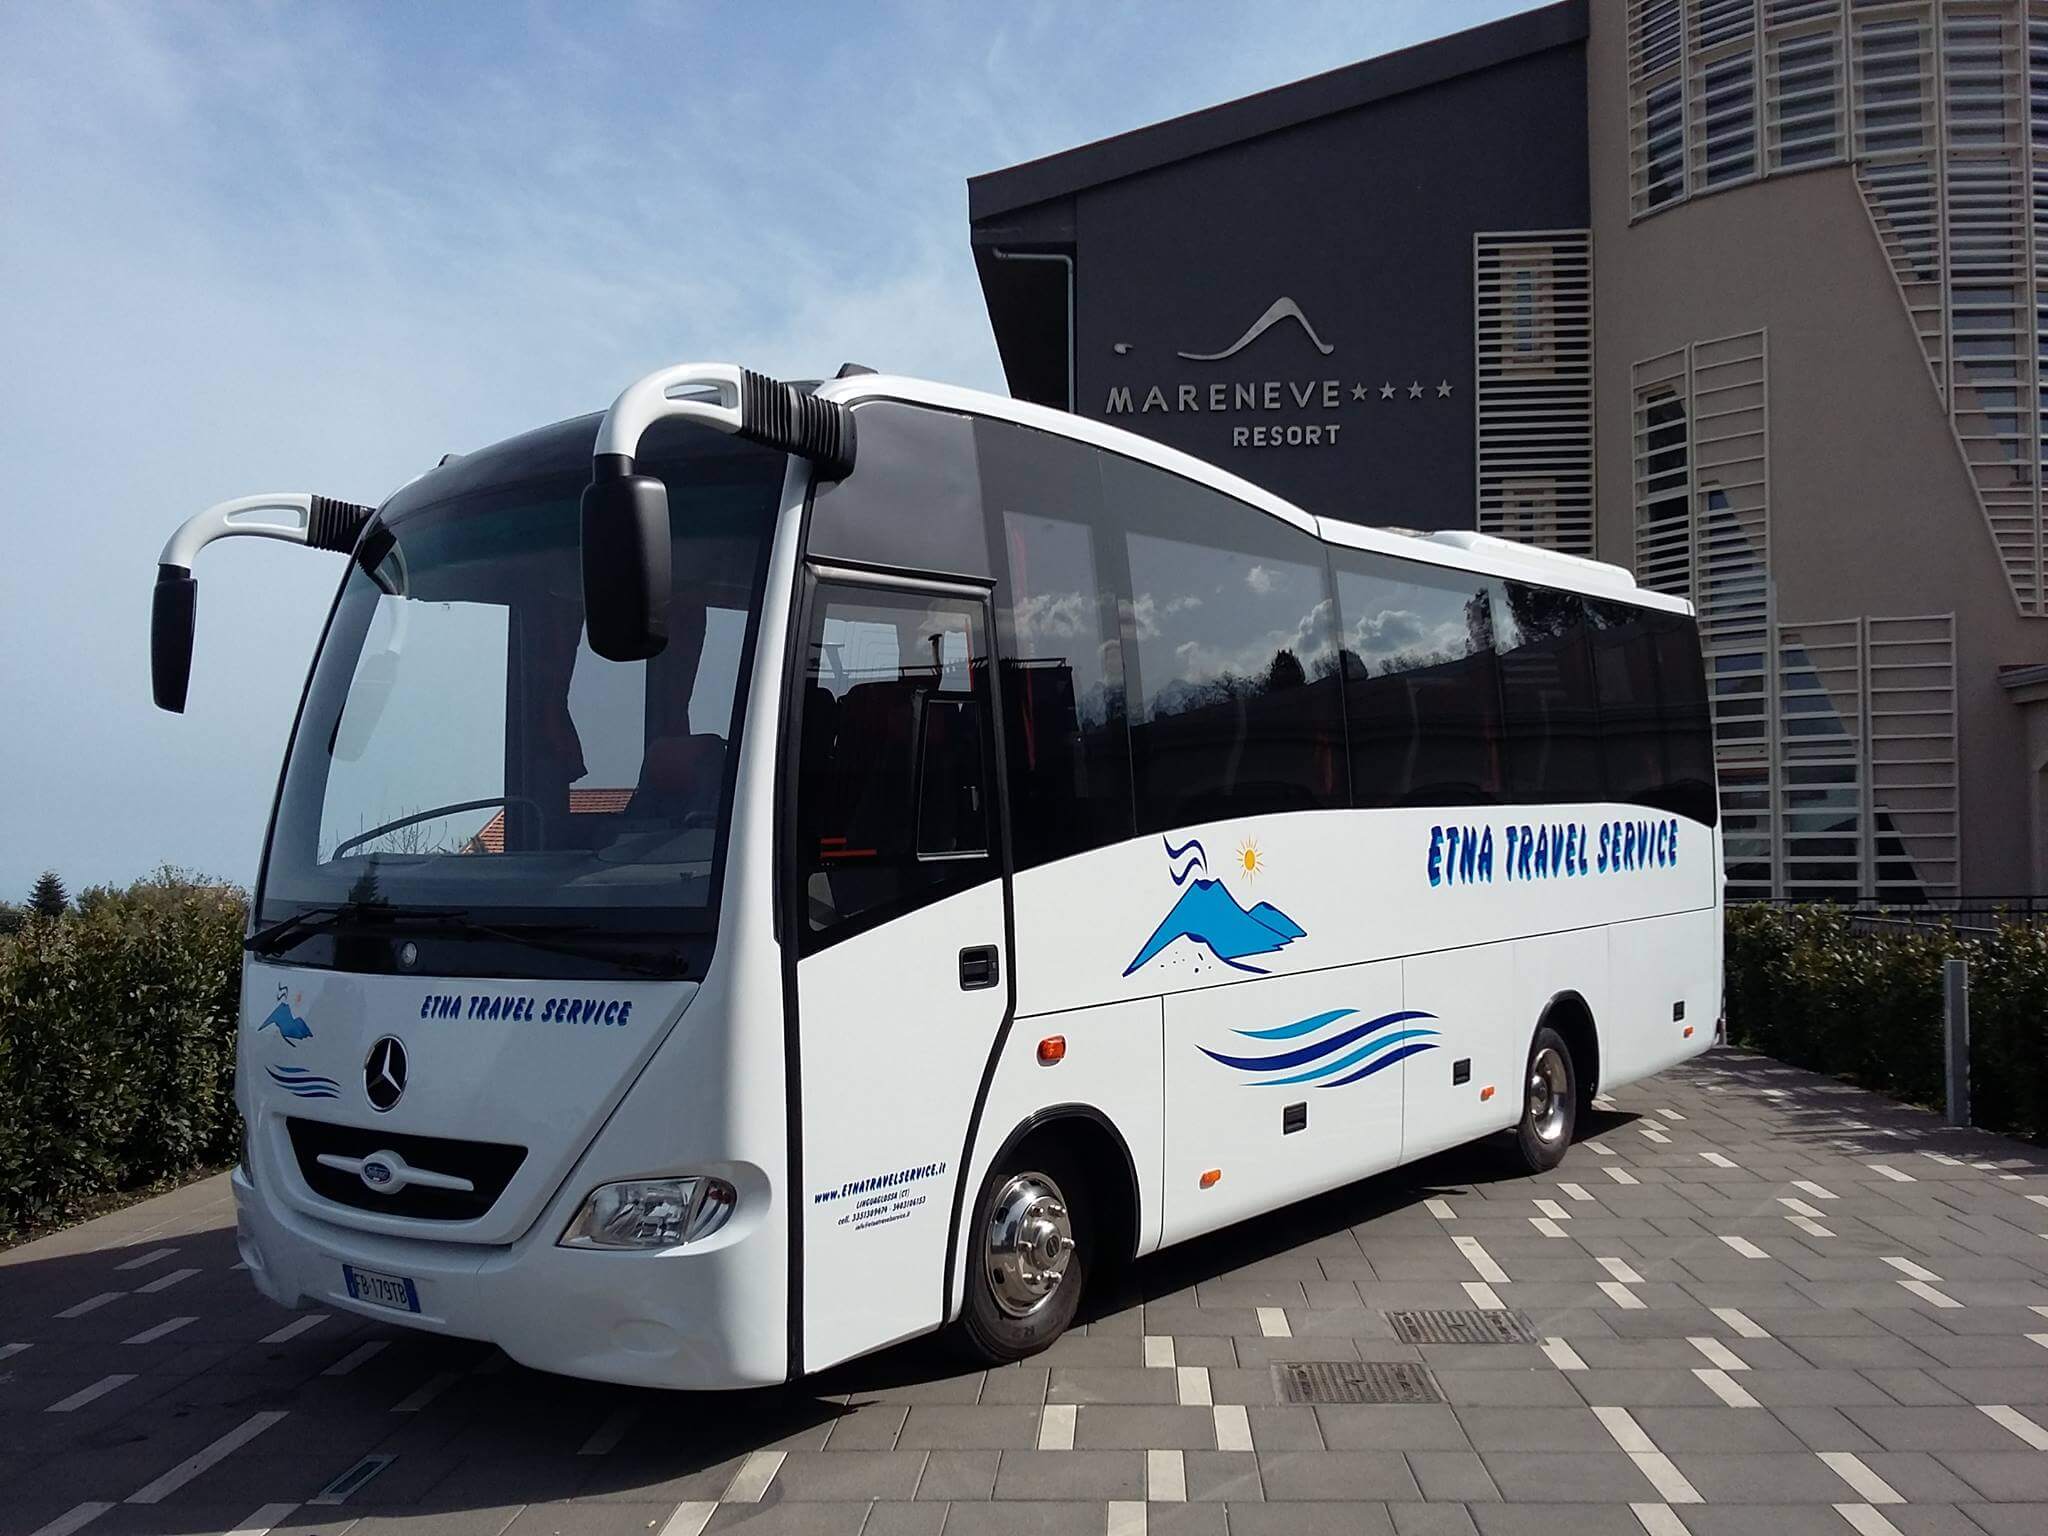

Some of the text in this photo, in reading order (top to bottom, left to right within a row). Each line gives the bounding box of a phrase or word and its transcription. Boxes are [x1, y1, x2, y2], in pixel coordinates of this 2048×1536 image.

[1105, 380, 1341, 414] MARENEVE
[1232, 424, 1341, 447] RESORT
[1427, 819, 1678, 887] ETNA TRAVEL SERVICE
[421, 995, 632, 1026] ETNA TRAVEL SERVICE
[814, 1162, 947, 1204] www.ETNATRAVELSERVICE.it
